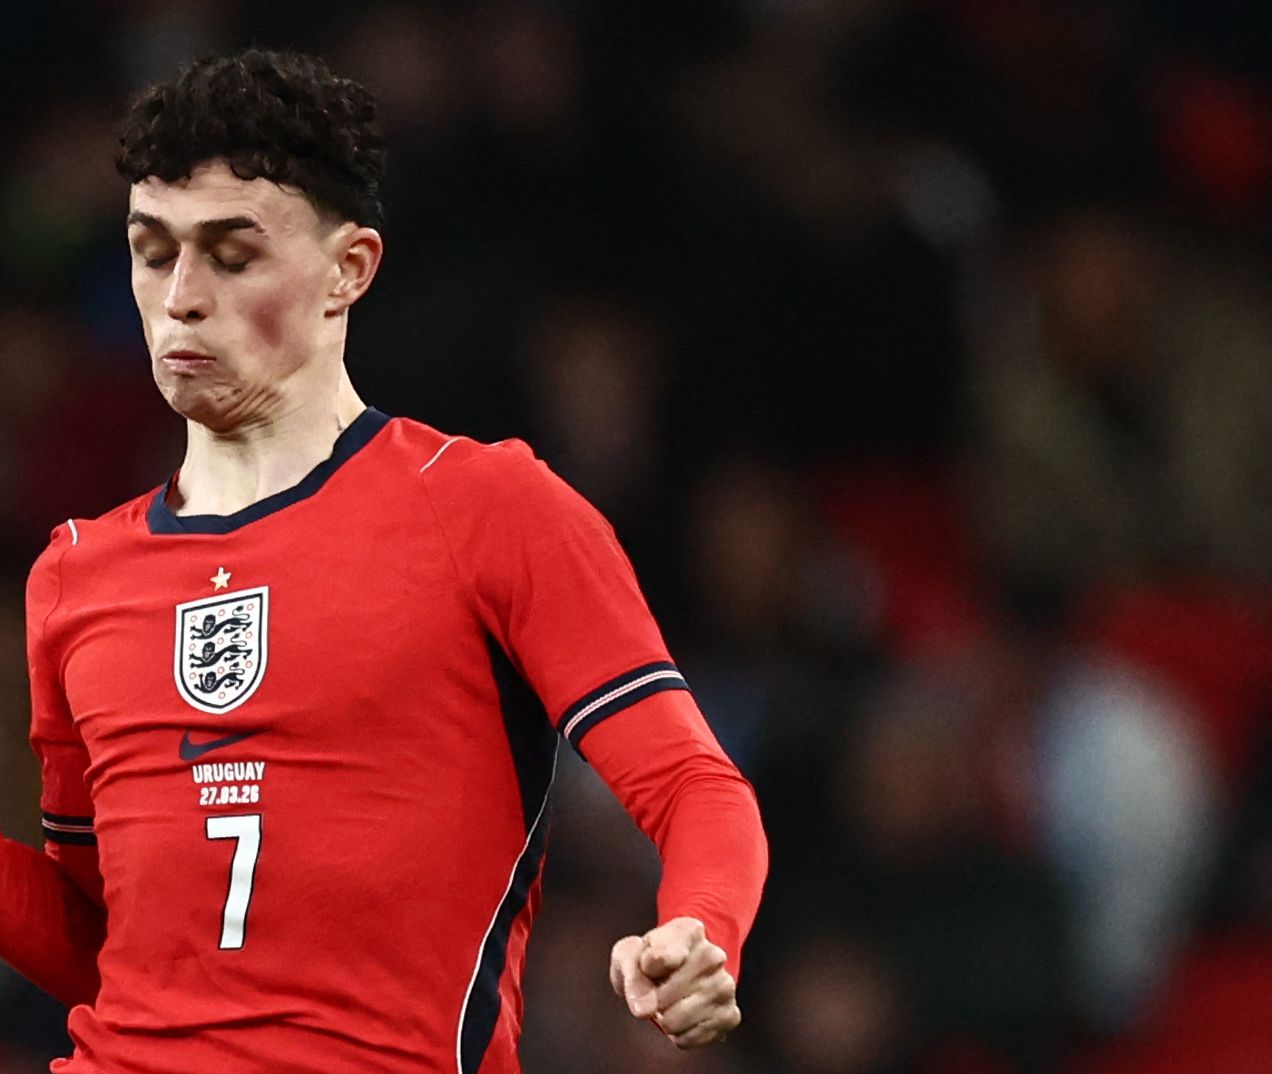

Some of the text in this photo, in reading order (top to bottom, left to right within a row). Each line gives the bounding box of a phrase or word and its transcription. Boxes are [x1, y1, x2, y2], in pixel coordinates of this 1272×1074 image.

[192, 762, 265, 783] URUGUAY
[199, 785, 260, 805] 27.03.26
[206, 814, 261, 949] 7
